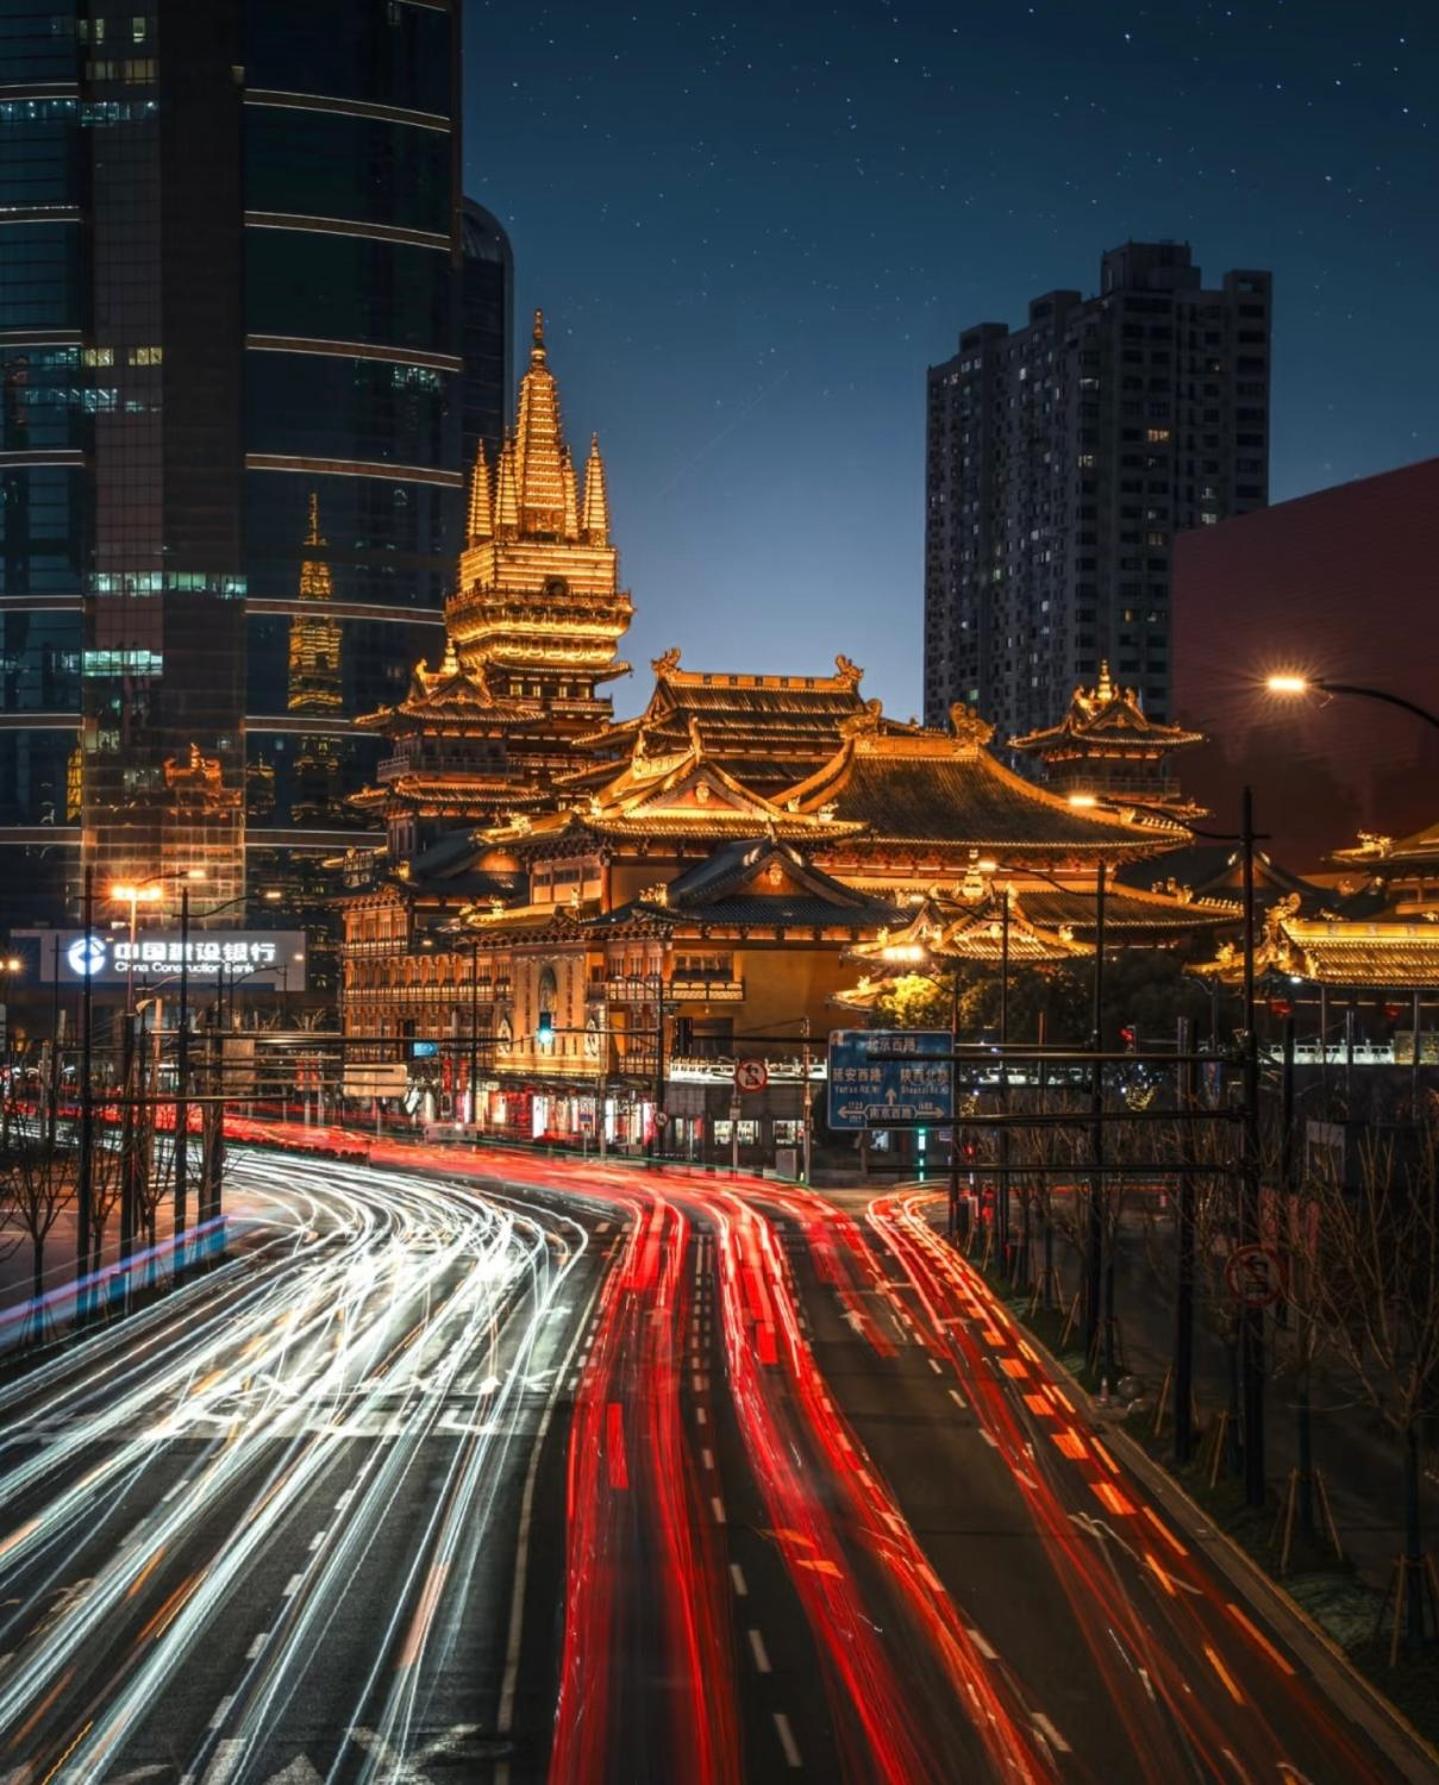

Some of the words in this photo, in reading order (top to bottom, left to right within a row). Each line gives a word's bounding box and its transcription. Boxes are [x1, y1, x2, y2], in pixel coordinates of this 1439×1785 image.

[114, 942, 276, 962] 中国建设银行
[114, 961, 149, 972] Chna
